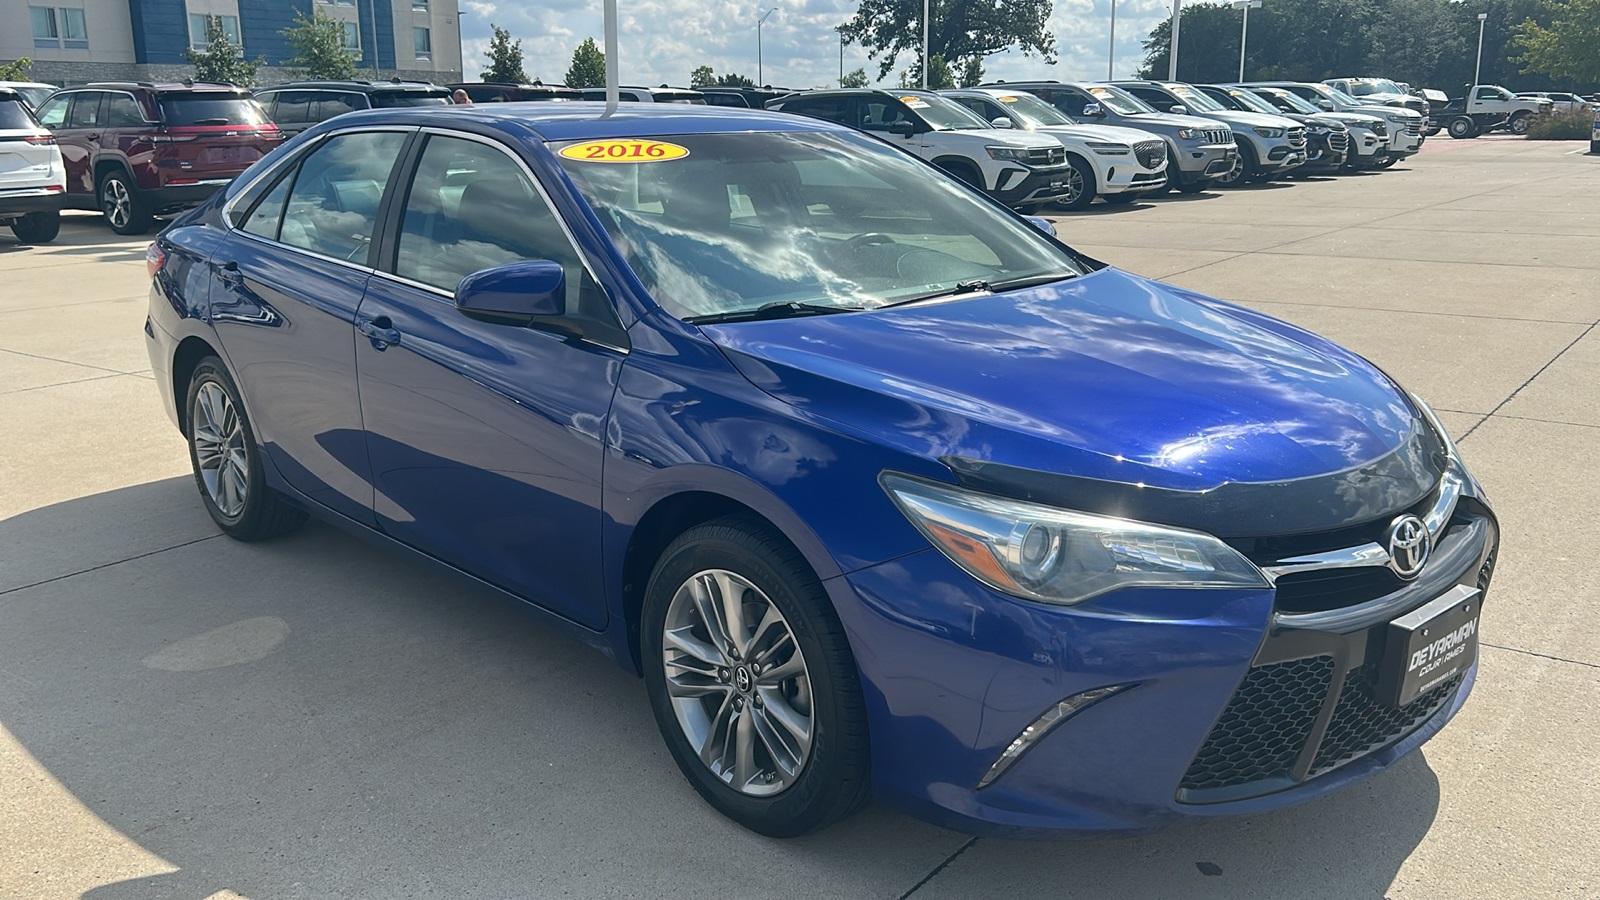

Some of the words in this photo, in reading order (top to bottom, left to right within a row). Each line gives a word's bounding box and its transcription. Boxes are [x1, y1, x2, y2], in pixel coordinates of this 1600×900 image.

[586, 144, 665, 159] 2016
[1408, 617, 1478, 672] DEYARMAN
[1444, 643, 1465, 663] AMES
